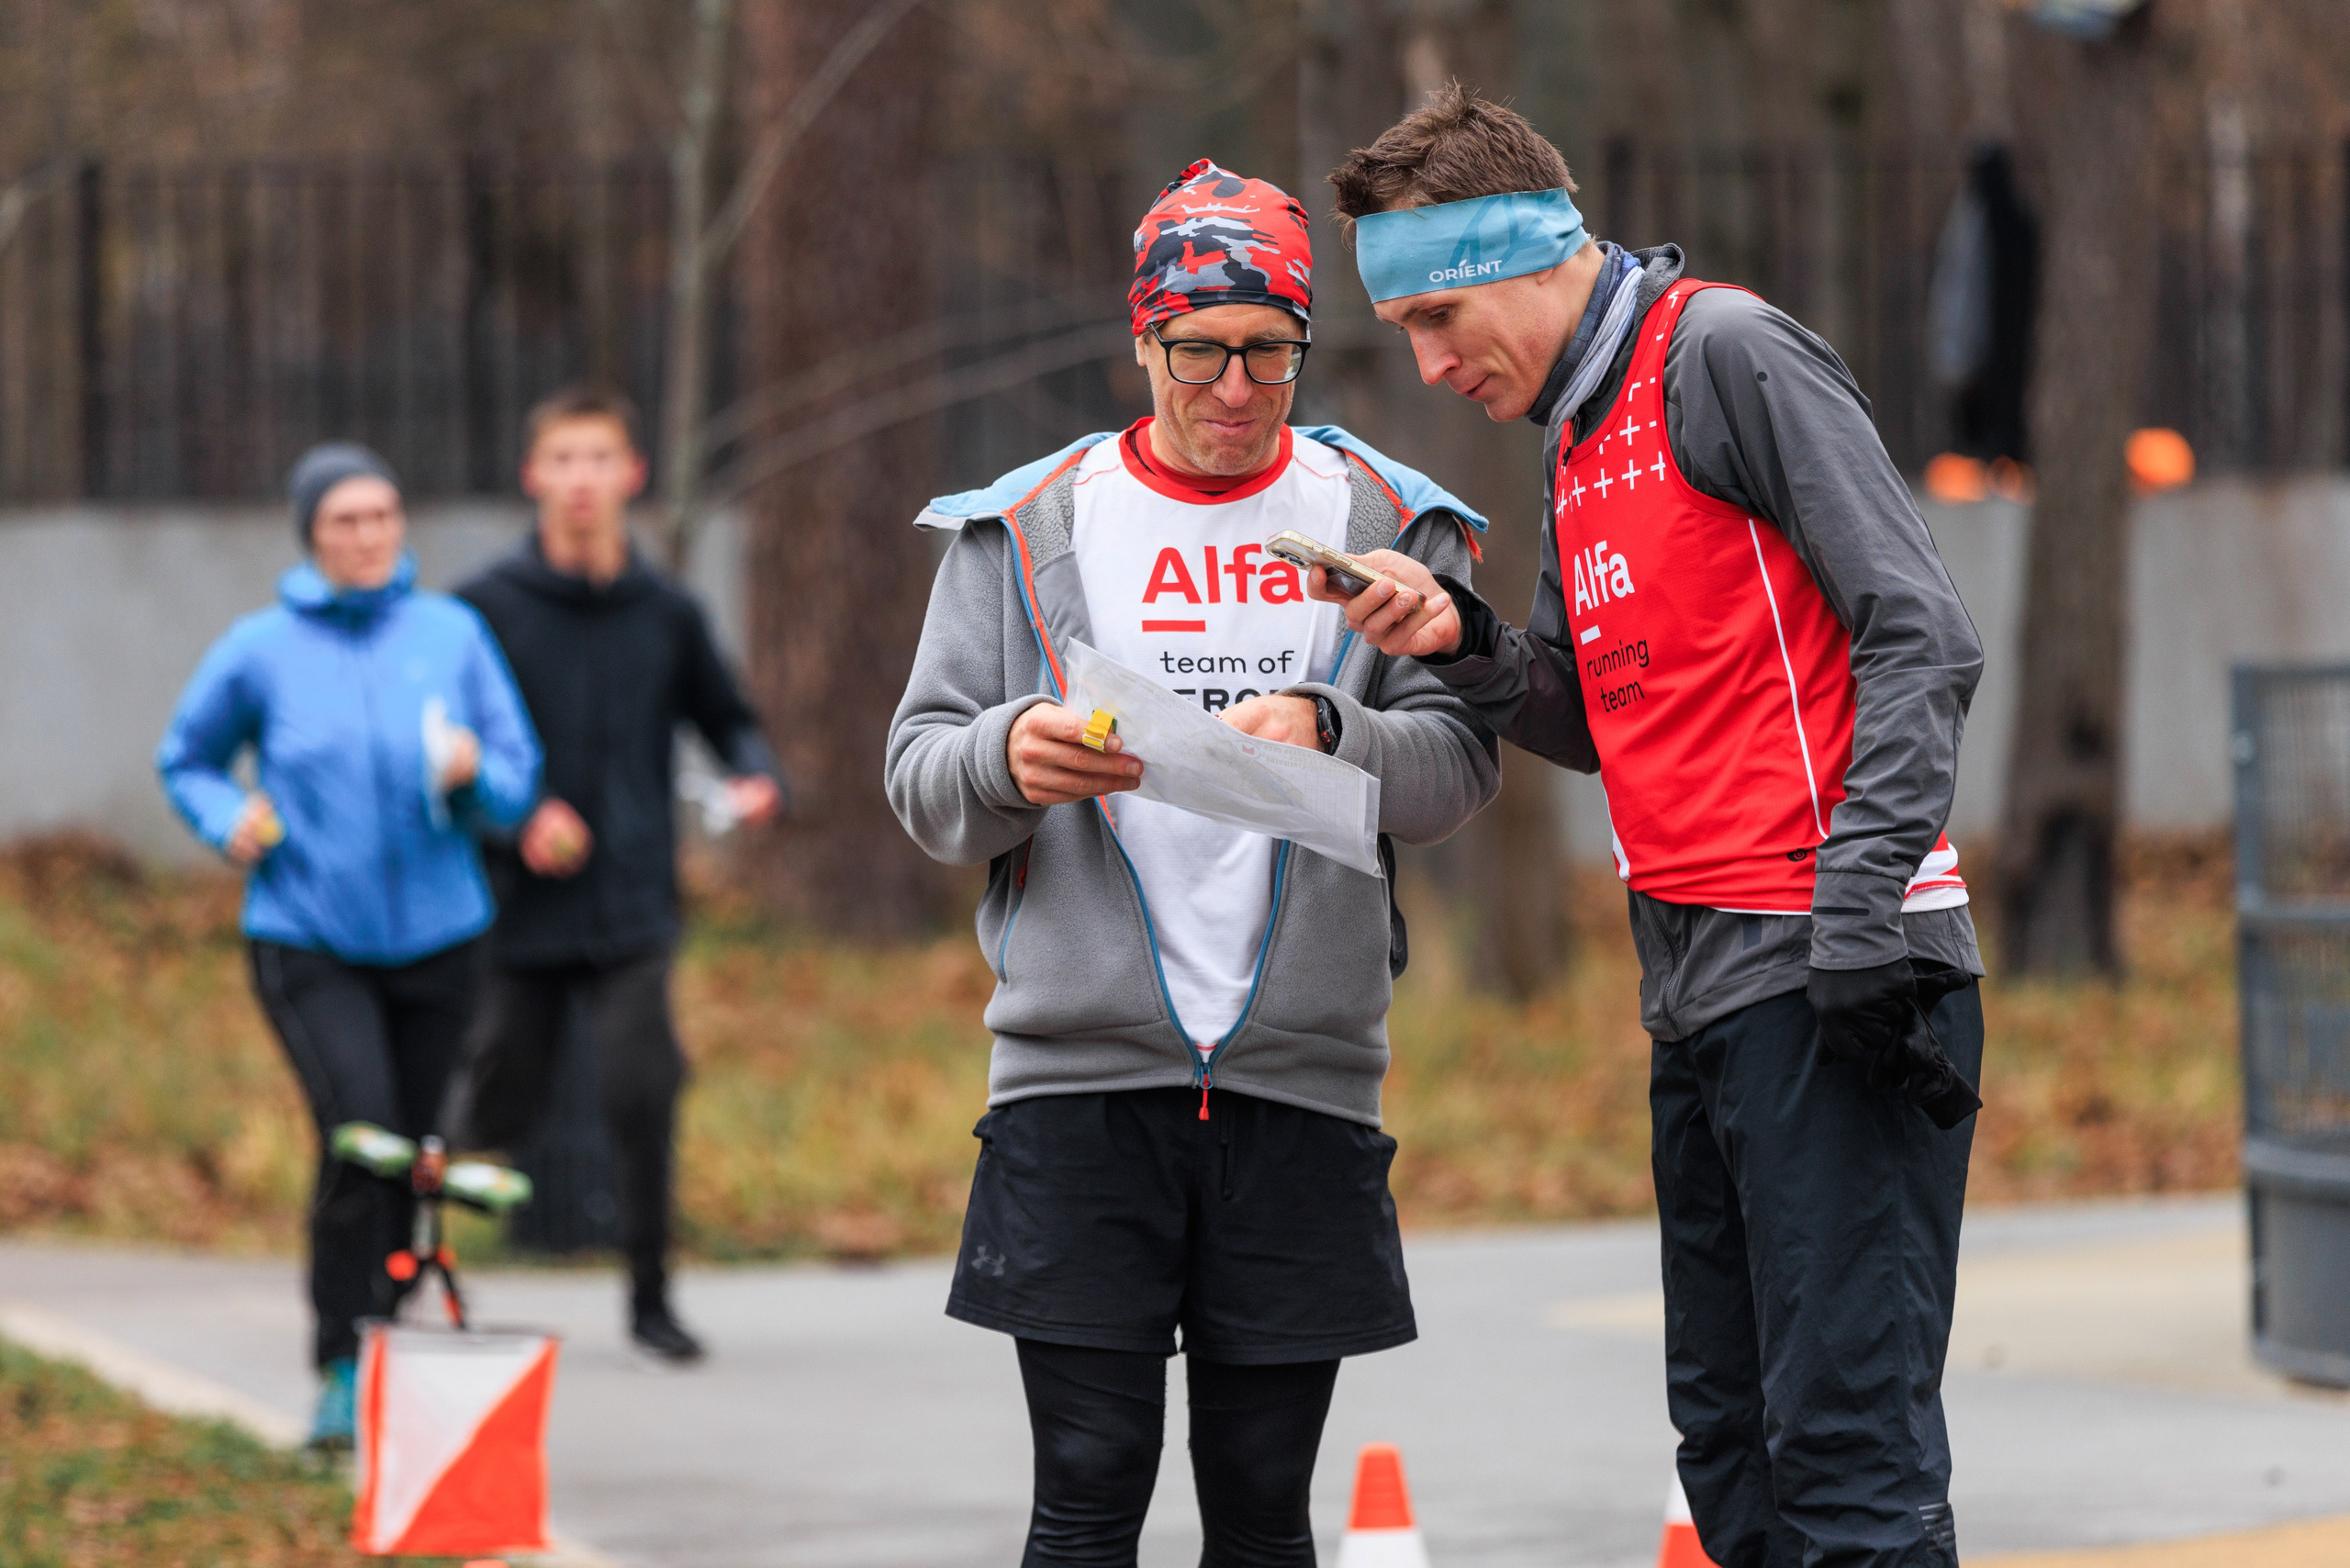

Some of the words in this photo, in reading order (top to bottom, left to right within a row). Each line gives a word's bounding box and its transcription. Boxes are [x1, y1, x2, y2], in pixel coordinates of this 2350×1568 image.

[1428, 259, 1503, 283] ORIENT
[1141, 543, 1304, 605] Alfa
[1574, 540, 1635, 616] Alfa
[1159, 651, 1246, 673] team
[1258, 650, 1295, 674] of
[1587, 639, 1651, 679] running
[1600, 680, 1646, 712] team
